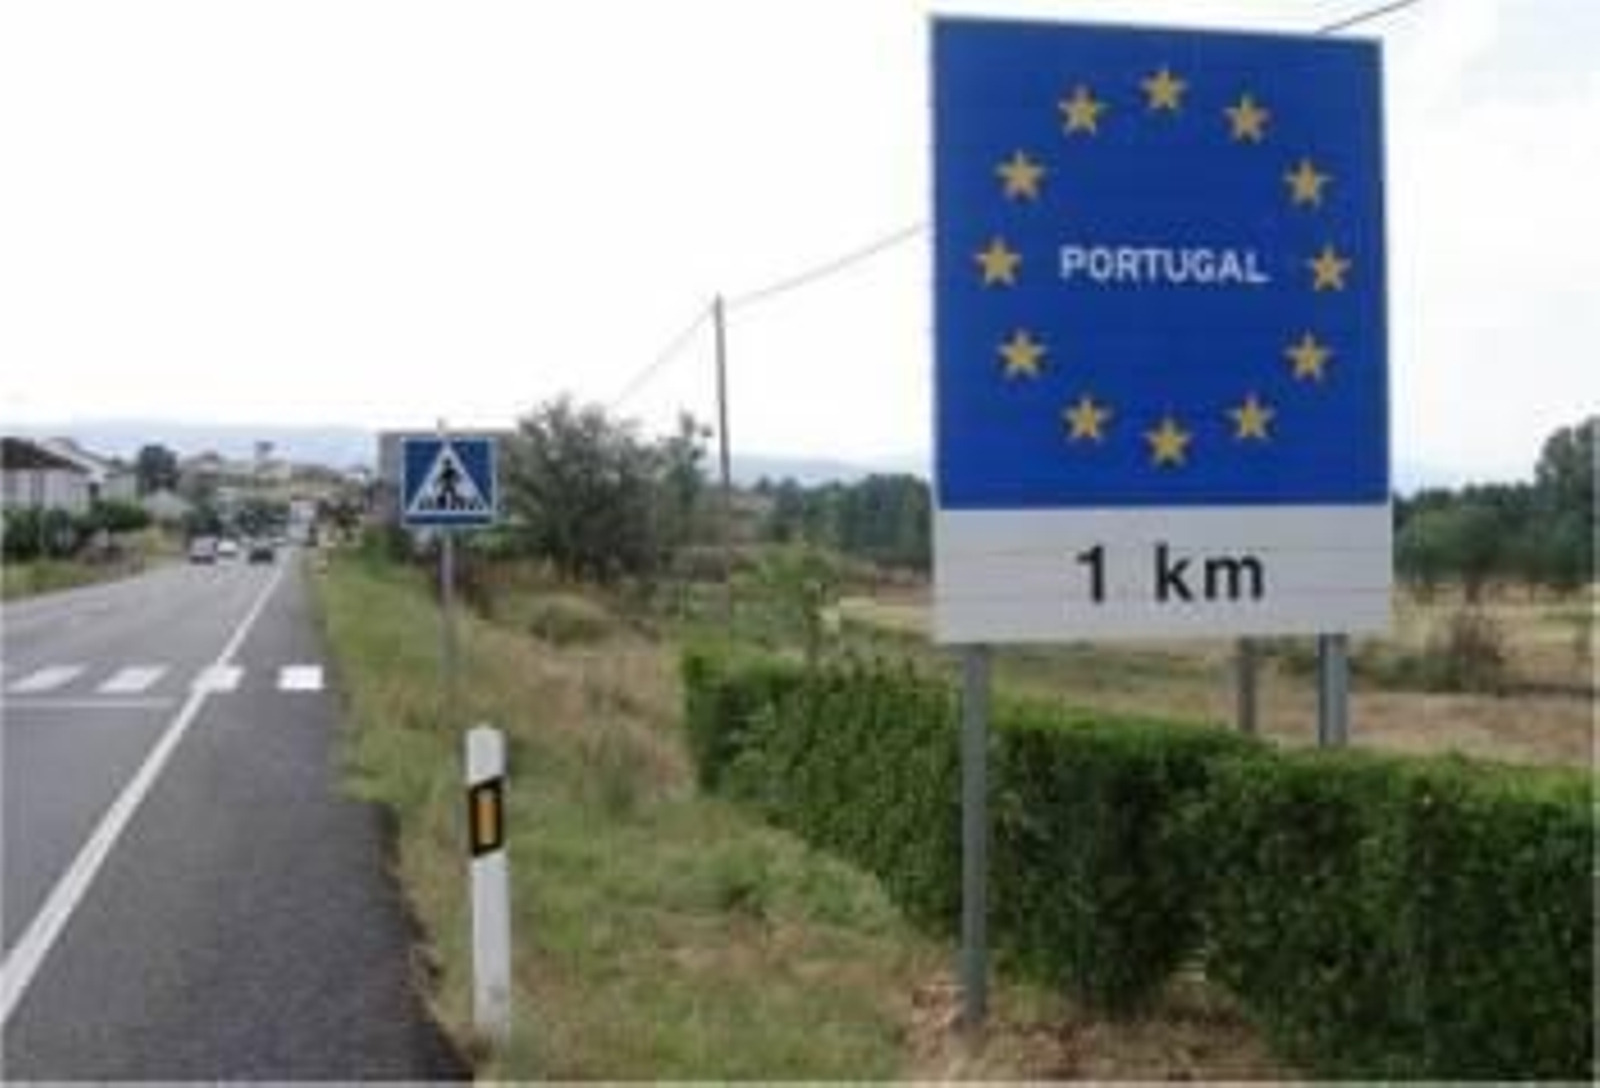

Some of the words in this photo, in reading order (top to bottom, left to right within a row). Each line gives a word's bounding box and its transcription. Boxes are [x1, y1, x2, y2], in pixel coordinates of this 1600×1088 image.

[1060, 246, 1269, 283] PORTUGAL
[1076, 544, 1105, 604] 1
[1154, 542, 1265, 603] km
